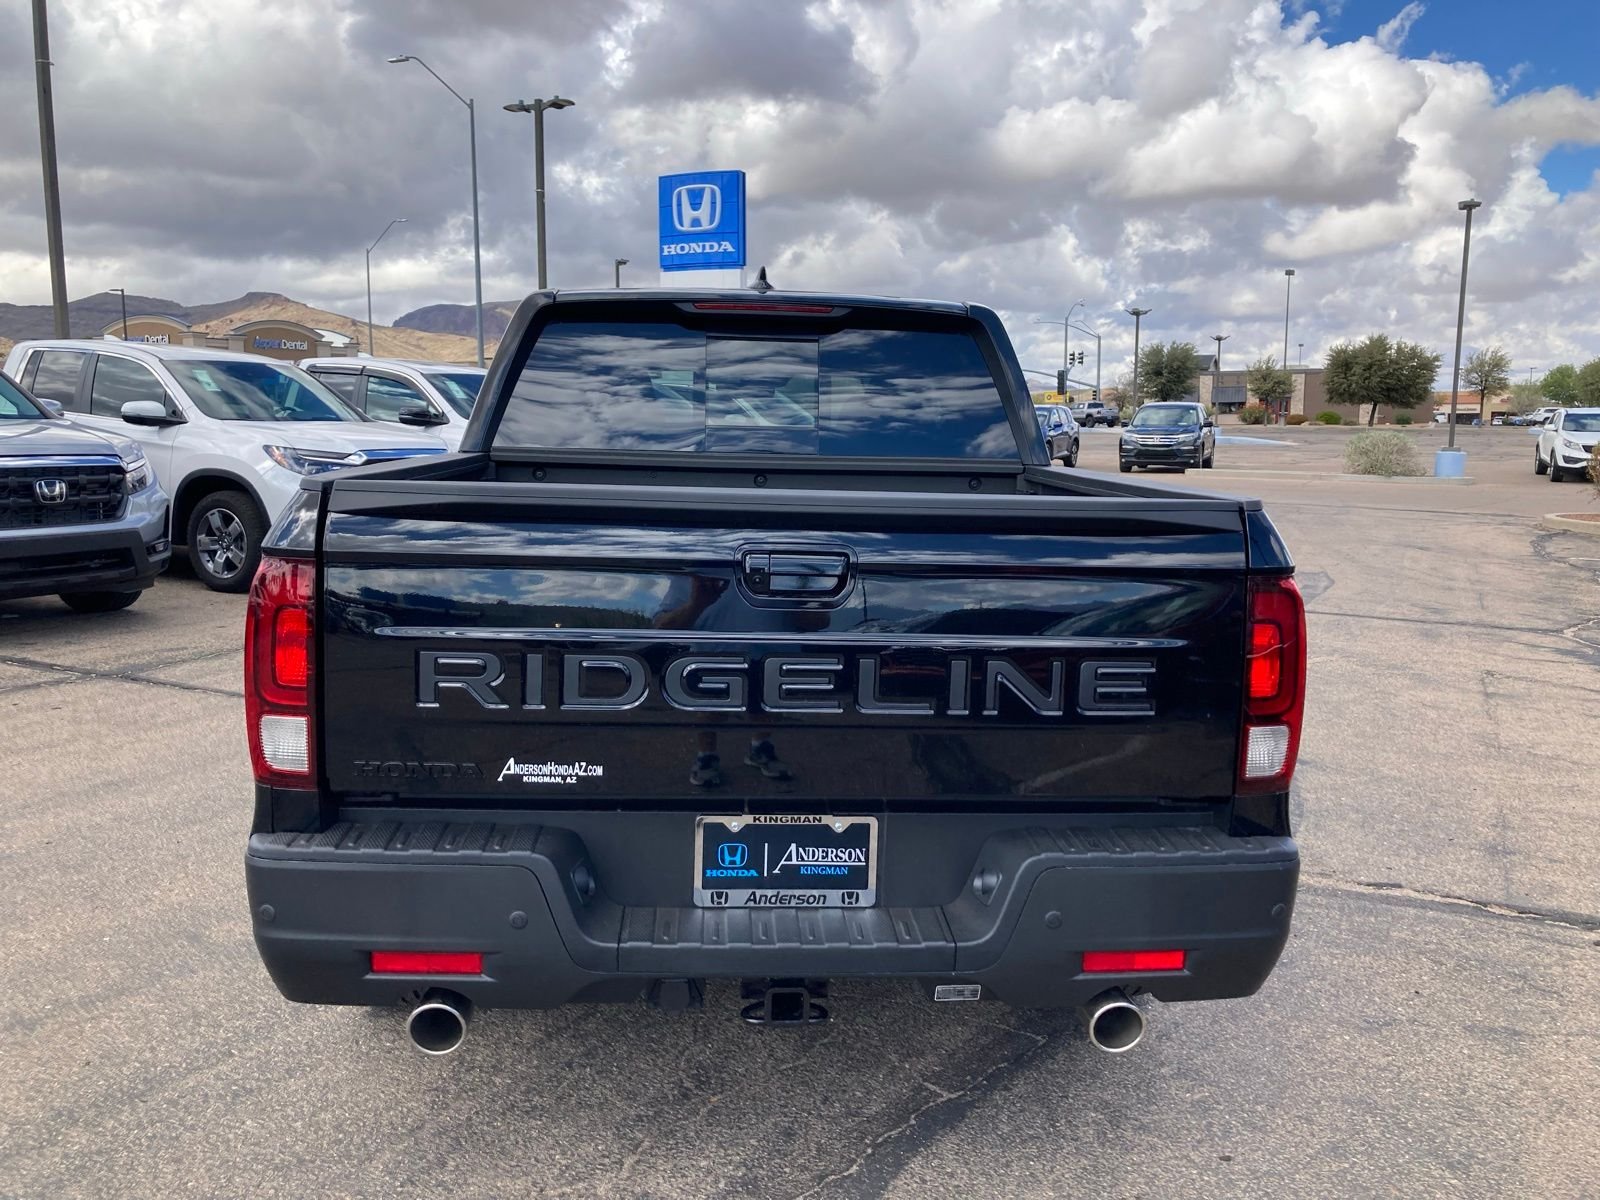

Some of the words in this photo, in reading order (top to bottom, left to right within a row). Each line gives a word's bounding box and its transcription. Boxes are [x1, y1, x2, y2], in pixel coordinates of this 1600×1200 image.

[662, 241, 736, 256] HONDA
[416, 650, 1157, 717] RIDGELINE
[352, 760, 487, 778] HONDA
[523, 775, 564, 784] KINGMAN,
[565, 776, 577, 784] AZ
[752, 815, 823, 824] KINGMAN
[772, 843, 866, 874] ANDERSON
[705, 869, 759, 877] HONDA
[800, 866, 848, 875] KINGMAN
[744, 890, 827, 906] Anderson
